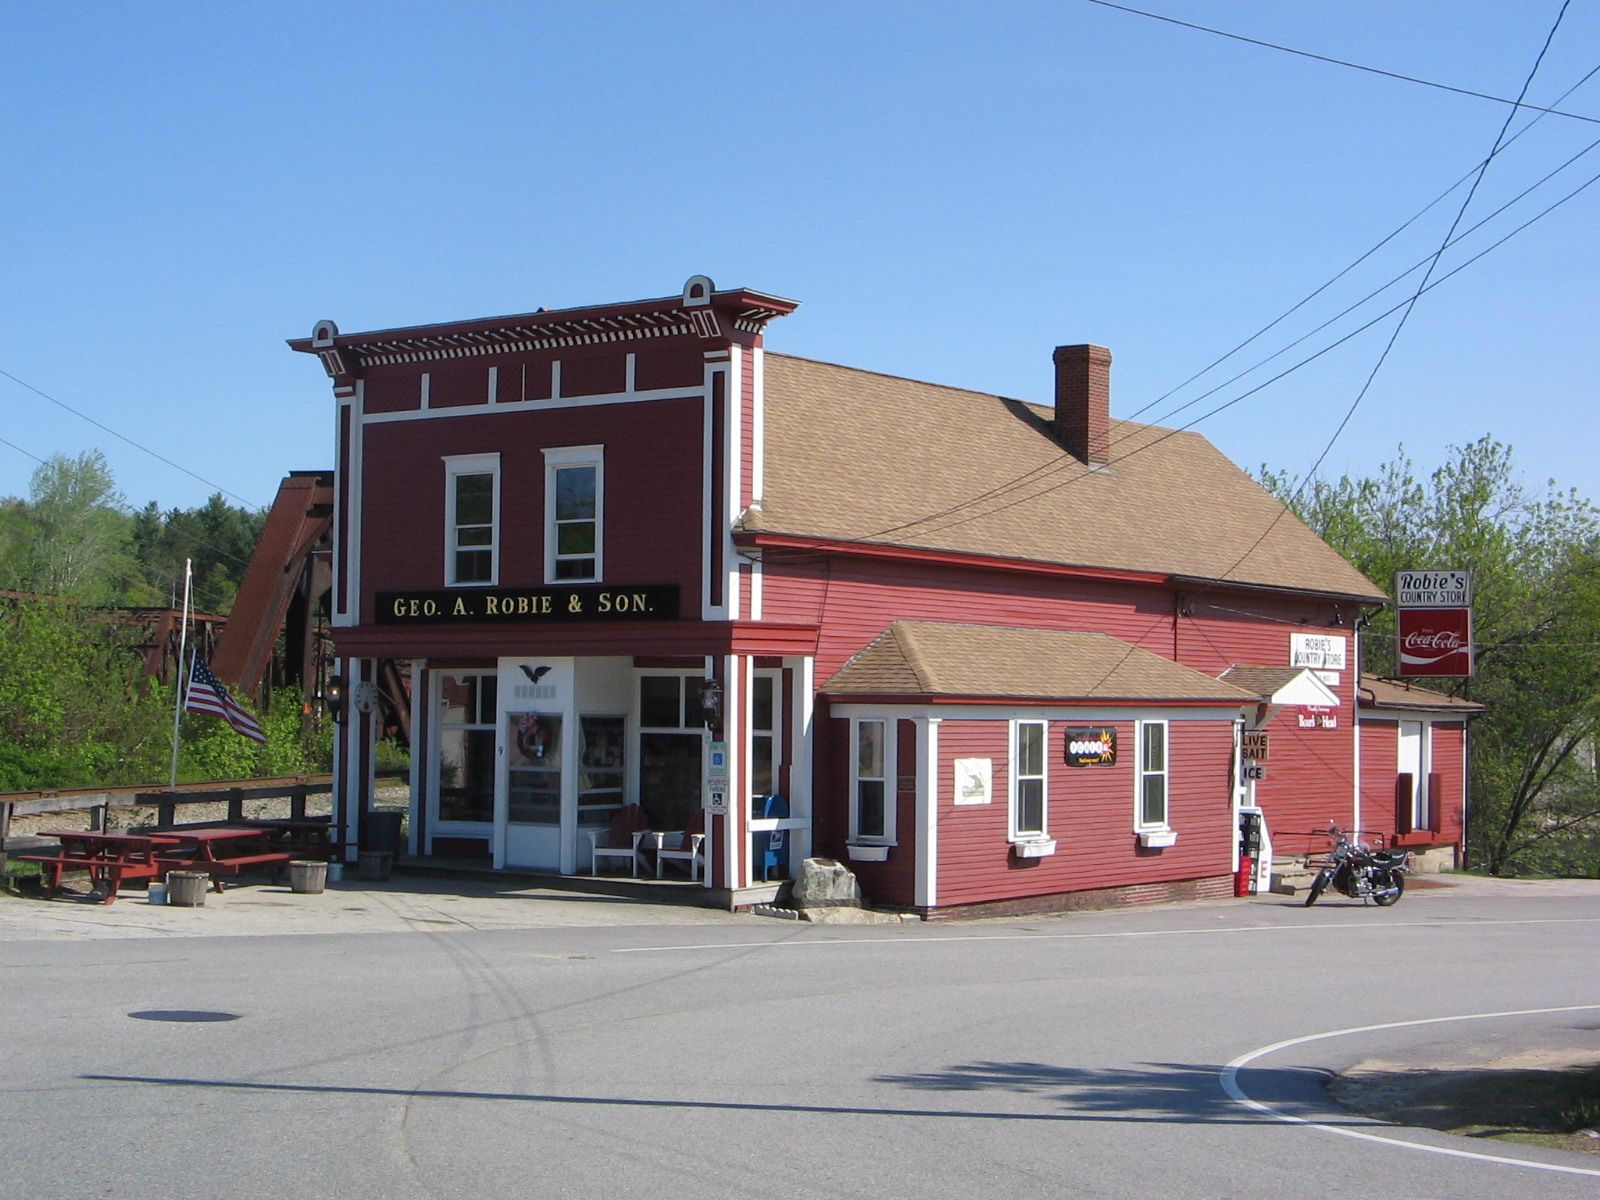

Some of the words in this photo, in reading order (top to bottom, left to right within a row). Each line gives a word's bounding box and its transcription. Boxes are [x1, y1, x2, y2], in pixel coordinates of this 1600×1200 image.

[1400, 573, 1465, 590] Robie's
[1400, 590, 1437, 603] COUNTRY
[1440, 590, 1466, 603] STORE
[393, 598, 442, 617] GEO.
[453, 597, 474, 616] A.
[486, 596, 552, 615] ROBIE
[568, 594, 583, 612] &
[598, 593, 654, 612] SON.
[1305, 637, 1332, 651] ROBIE'S
[1404, 631, 1460, 649] Coca-Cola
[1242, 735, 1266, 746] LIVE
[1242, 748, 1266, 759] BAIT
[1243, 767, 1262, 779] ICE
